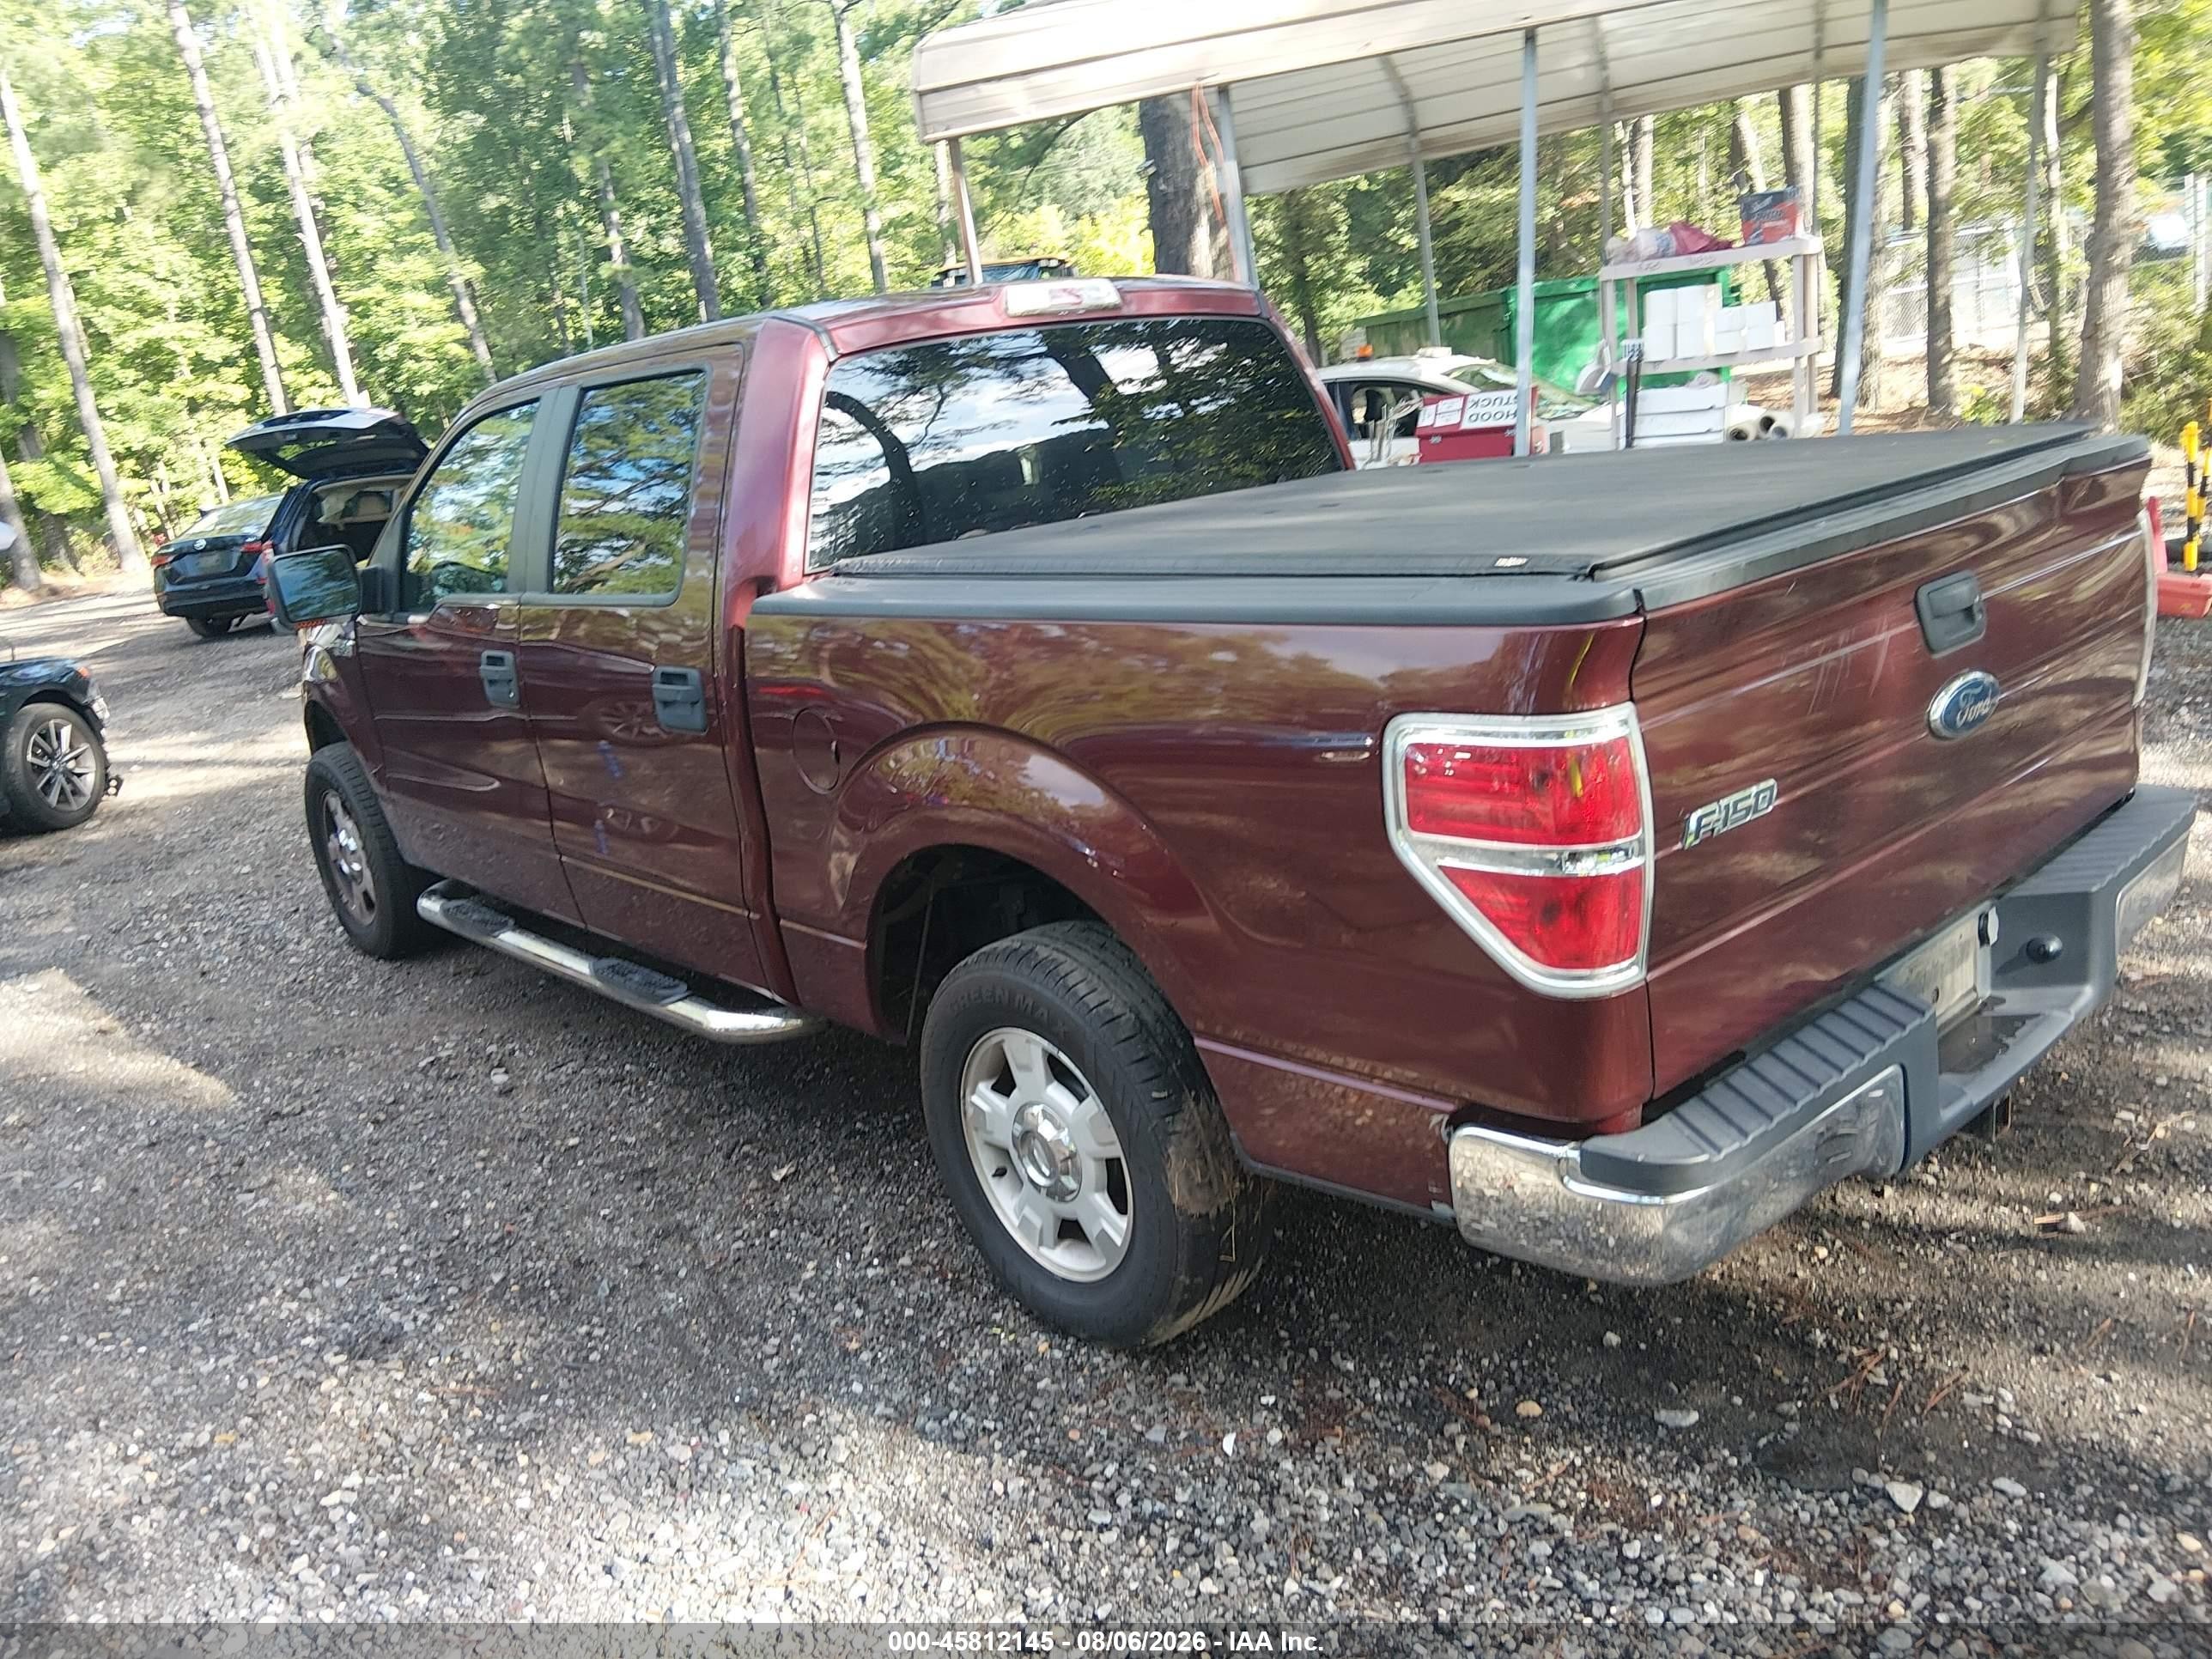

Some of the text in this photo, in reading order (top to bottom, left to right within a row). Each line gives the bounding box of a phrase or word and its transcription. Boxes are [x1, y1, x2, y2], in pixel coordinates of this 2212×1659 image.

[1468, 410, 1517, 422] HOOD
[1955, 684, 1993, 729] Ford
[1683, 778, 1778, 850] F-150
